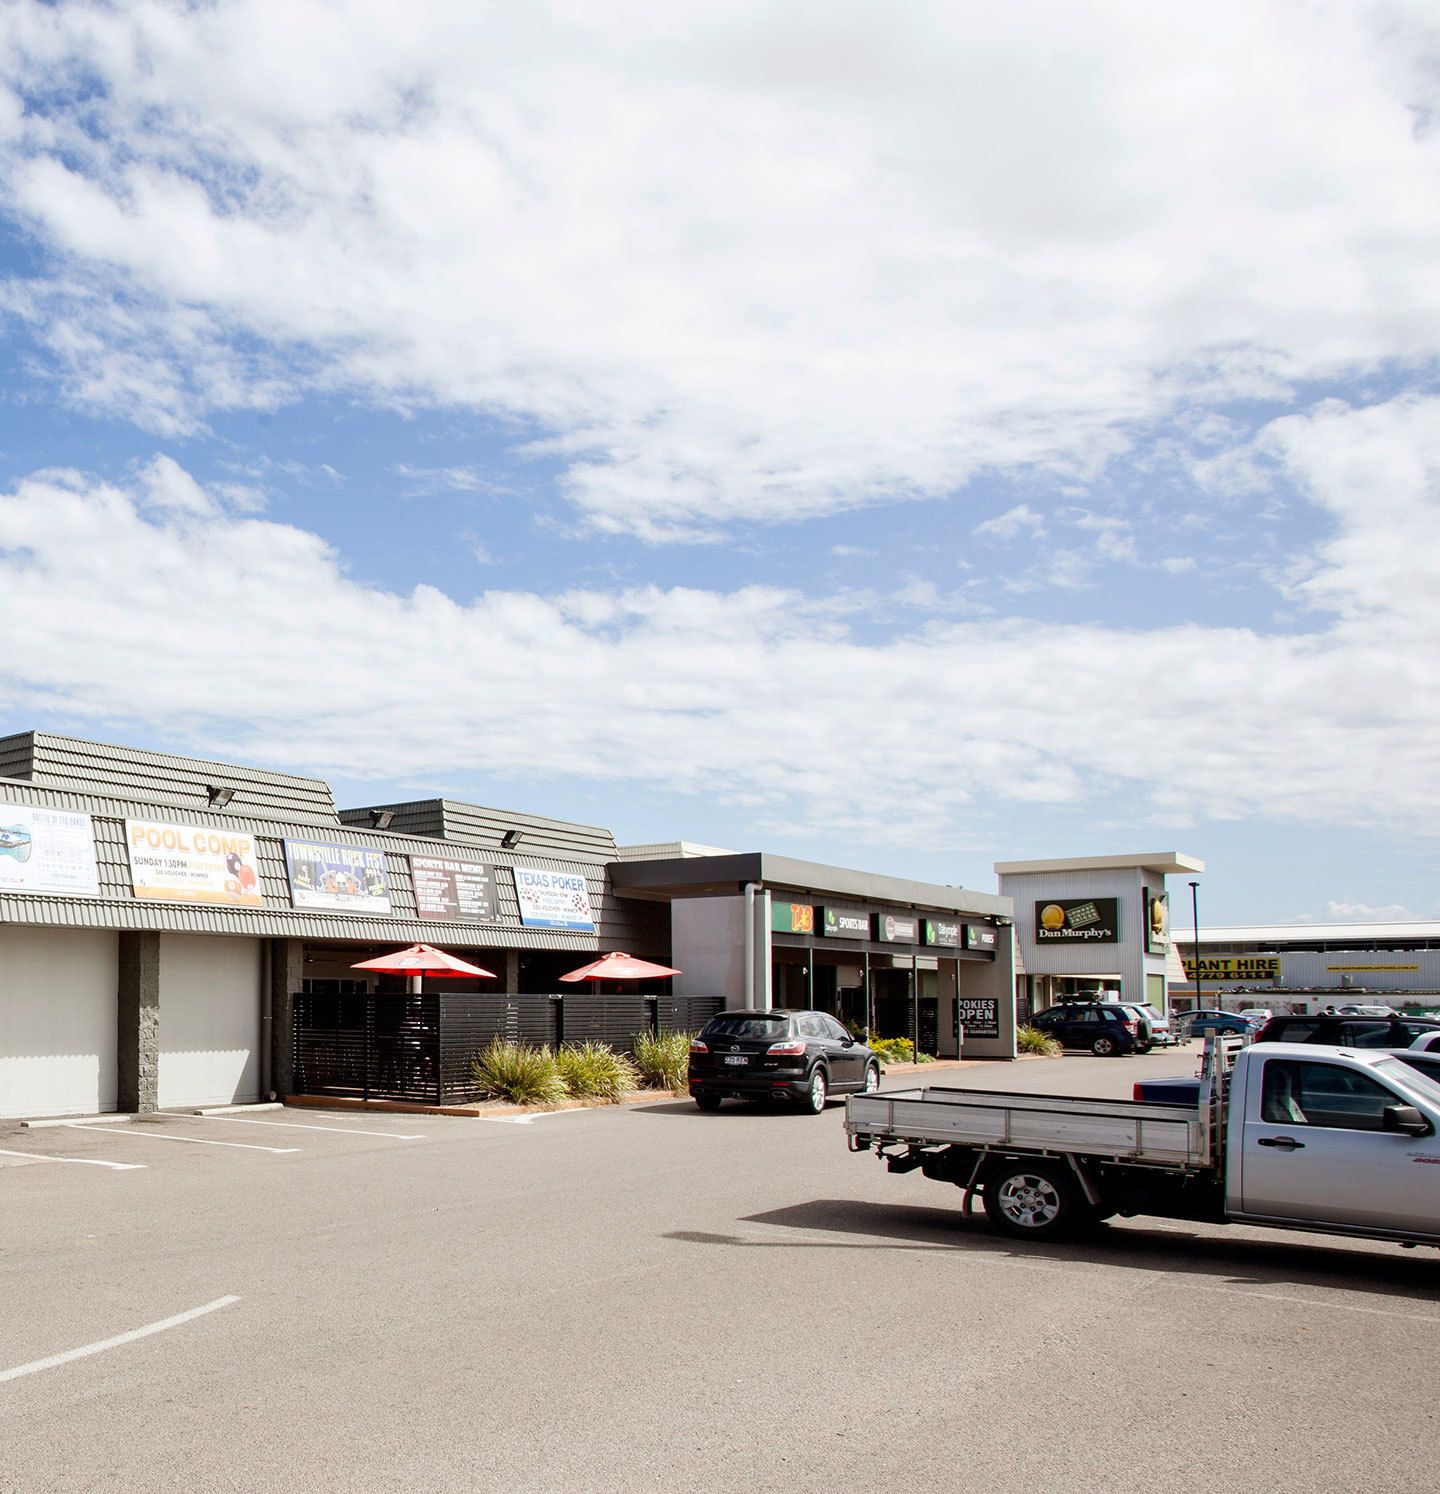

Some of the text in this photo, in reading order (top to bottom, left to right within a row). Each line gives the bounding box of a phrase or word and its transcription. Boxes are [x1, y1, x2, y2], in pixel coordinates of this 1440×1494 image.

[131, 824, 251, 857] POOL COMP
[133, 856, 166, 868] SUNDAY
[341, 848, 365, 868] ROCK
[365, 851, 383, 870] FEST
[412, 857, 484, 875] SPORTS BAR MENU
[517, 871, 585, 892] TEXAS POKER
[790, 903, 813, 932] TAB
[839, 917, 869, 931] SPORTS BAR
[1039, 927, 1112, 939] Dan Murphy's
[1237, 959, 1278, 970] HIRE
[960, 1000, 995, 1010] POKIES
[960, 1009, 994, 1020] OPEN
